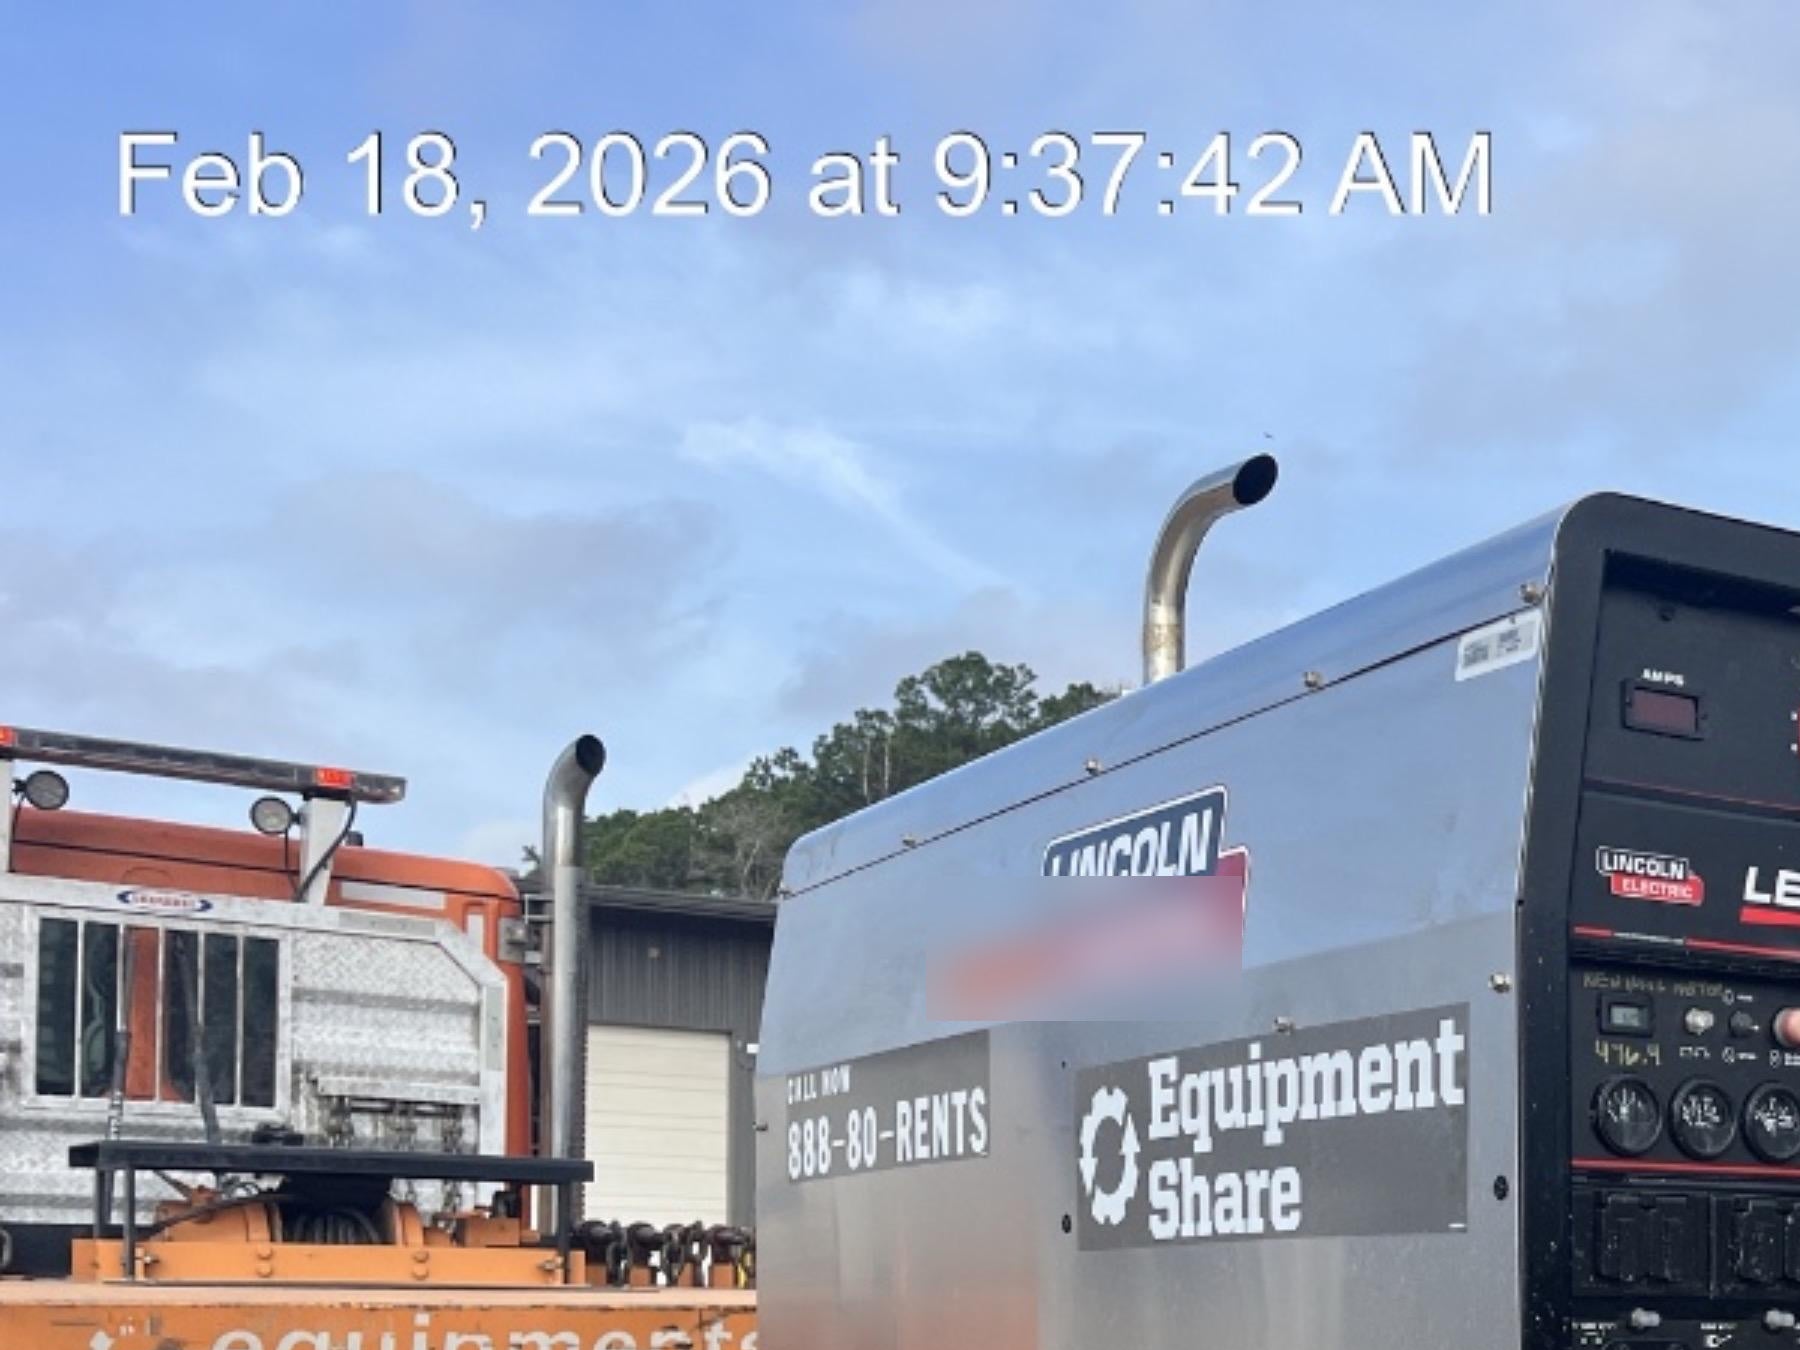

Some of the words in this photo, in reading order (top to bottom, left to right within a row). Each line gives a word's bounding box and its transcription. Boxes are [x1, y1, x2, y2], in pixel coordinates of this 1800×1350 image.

[1641, 668, 1685, 687] AMPS
[1603, 853, 1686, 880] LINCOLN
[1621, 875, 1693, 899] ELECTRIC
[821, 1064, 851, 1097] NOW
[1147, 1017, 1465, 1153] Equipment
[787, 1085, 988, 1180] 888-80-RENTS
[1147, 1156, 1301, 1240] Share
